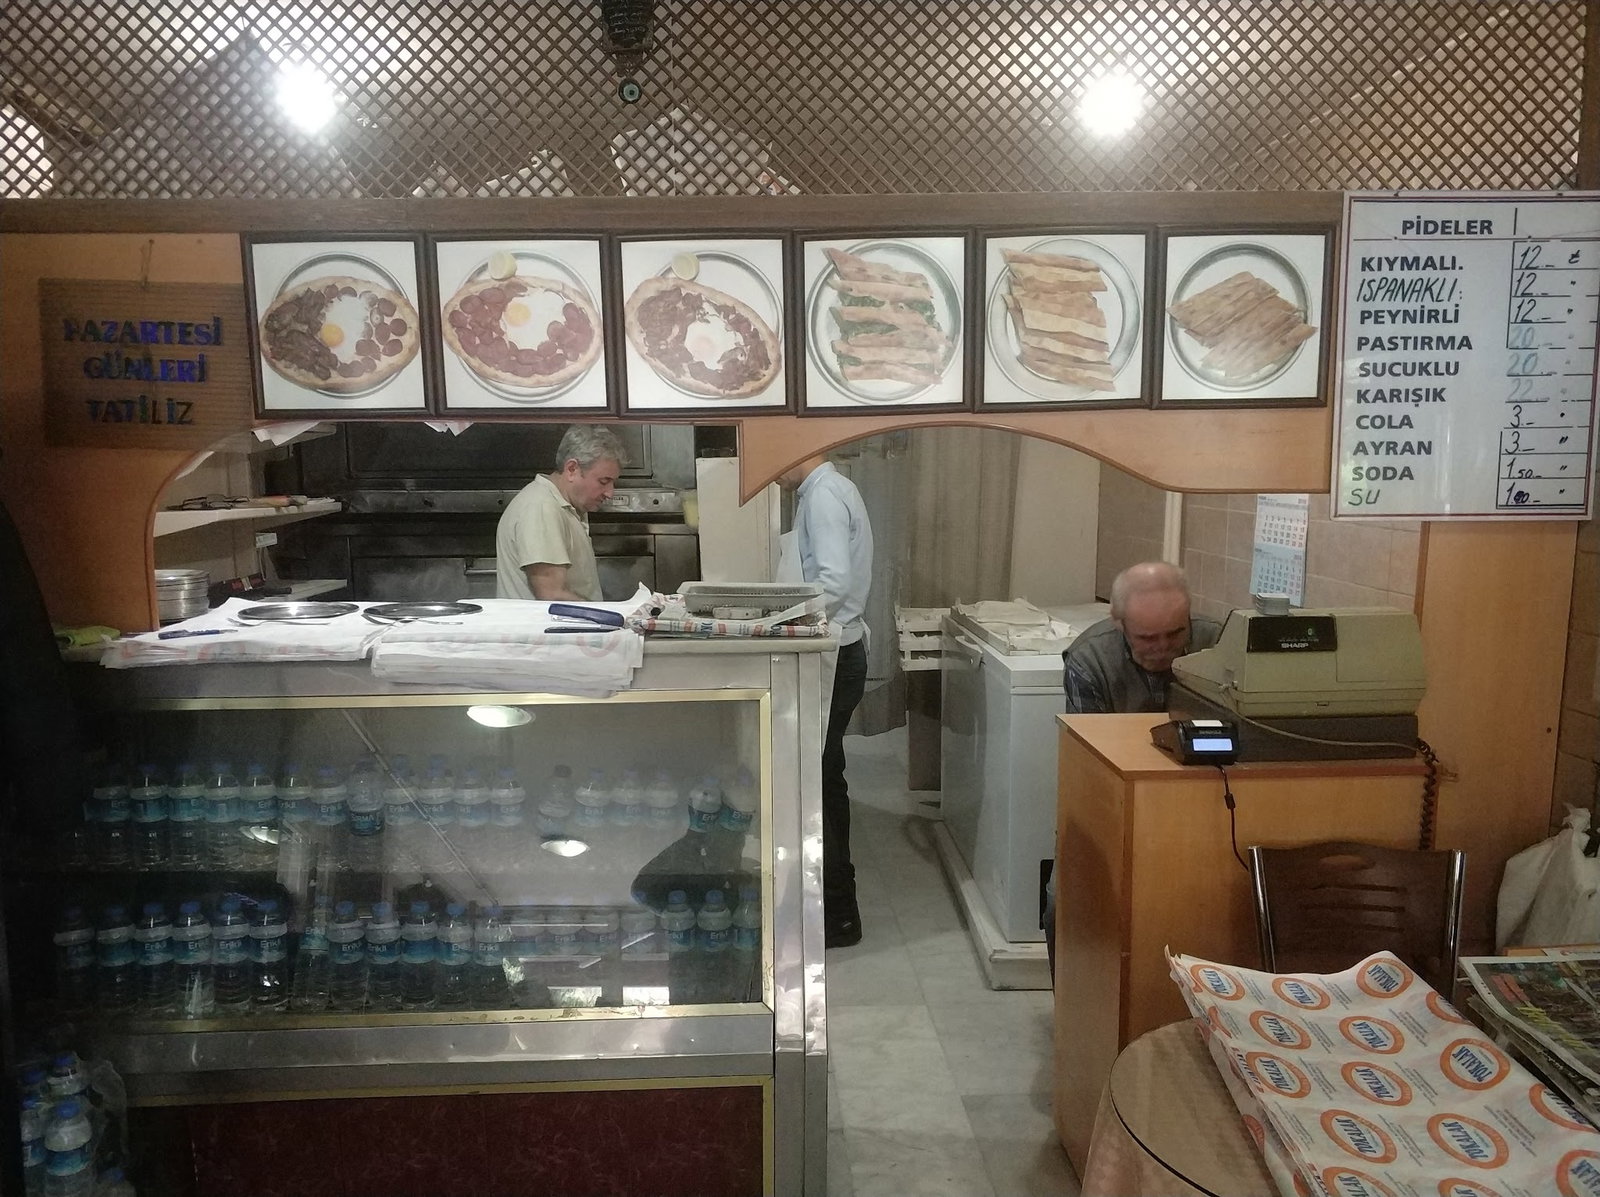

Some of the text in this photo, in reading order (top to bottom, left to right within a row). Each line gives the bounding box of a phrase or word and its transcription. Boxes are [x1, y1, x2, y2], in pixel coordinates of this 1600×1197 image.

[1402, 215, 1493, 235] PİDELER
[1360, 303, 1459, 324] PEYNİRLİ
[1357, 335, 1473, 351] PASTIRMA
[1359, 361, 1460, 378] SUCUKLU
[1356, 387, 1447, 408] KARIŞIK
[1355, 414, 1414, 429] COLA
[1353, 441, 1433, 456] AYRAN
[1351, 466, 1415, 481] SODA
[1348, 488, 1381, 506] SU
[1452, 1046, 1493, 1082] TOKALAK
[1442, 1121, 1489, 1159] TOKALAK
